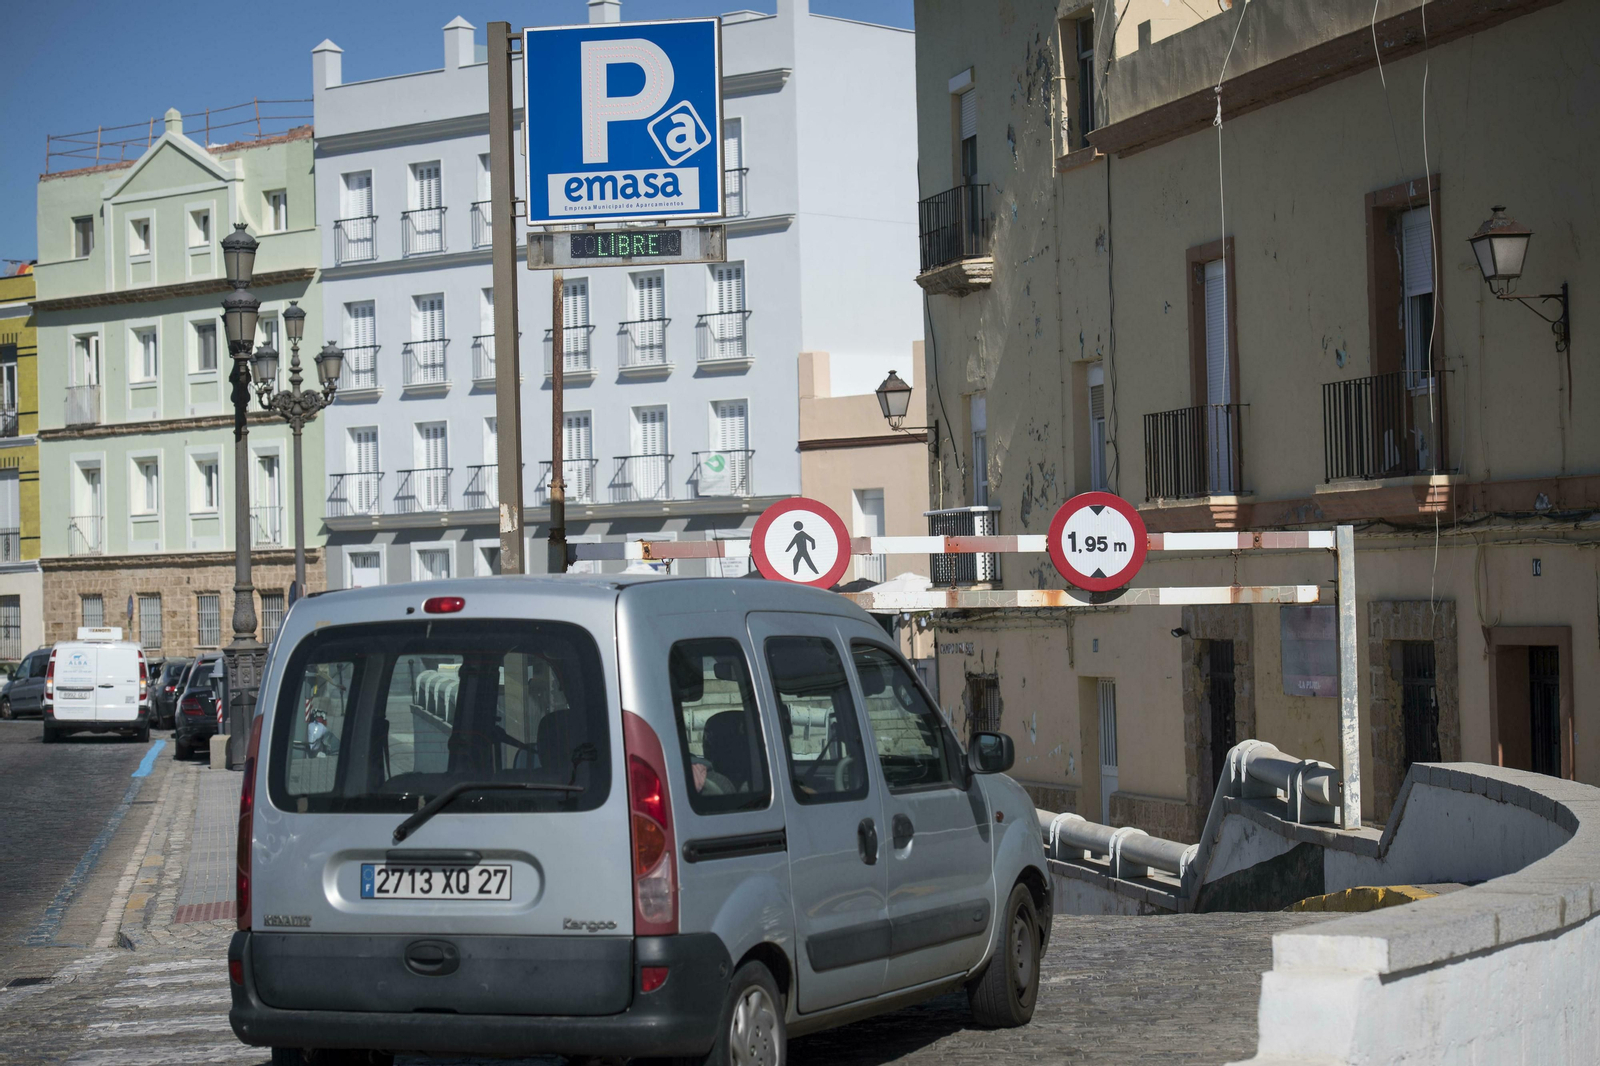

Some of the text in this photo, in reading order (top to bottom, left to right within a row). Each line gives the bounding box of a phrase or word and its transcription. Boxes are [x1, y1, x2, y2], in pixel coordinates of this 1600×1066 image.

[580, 38, 675, 164] P
[564, 172, 683, 202] emasa
[598, 233, 659, 256] LIBRE
[1067, 531, 1127, 554] 1,95 m
[365, 884, 371, 892] F
[376, 868, 507, 894] 2713 XQ 27
